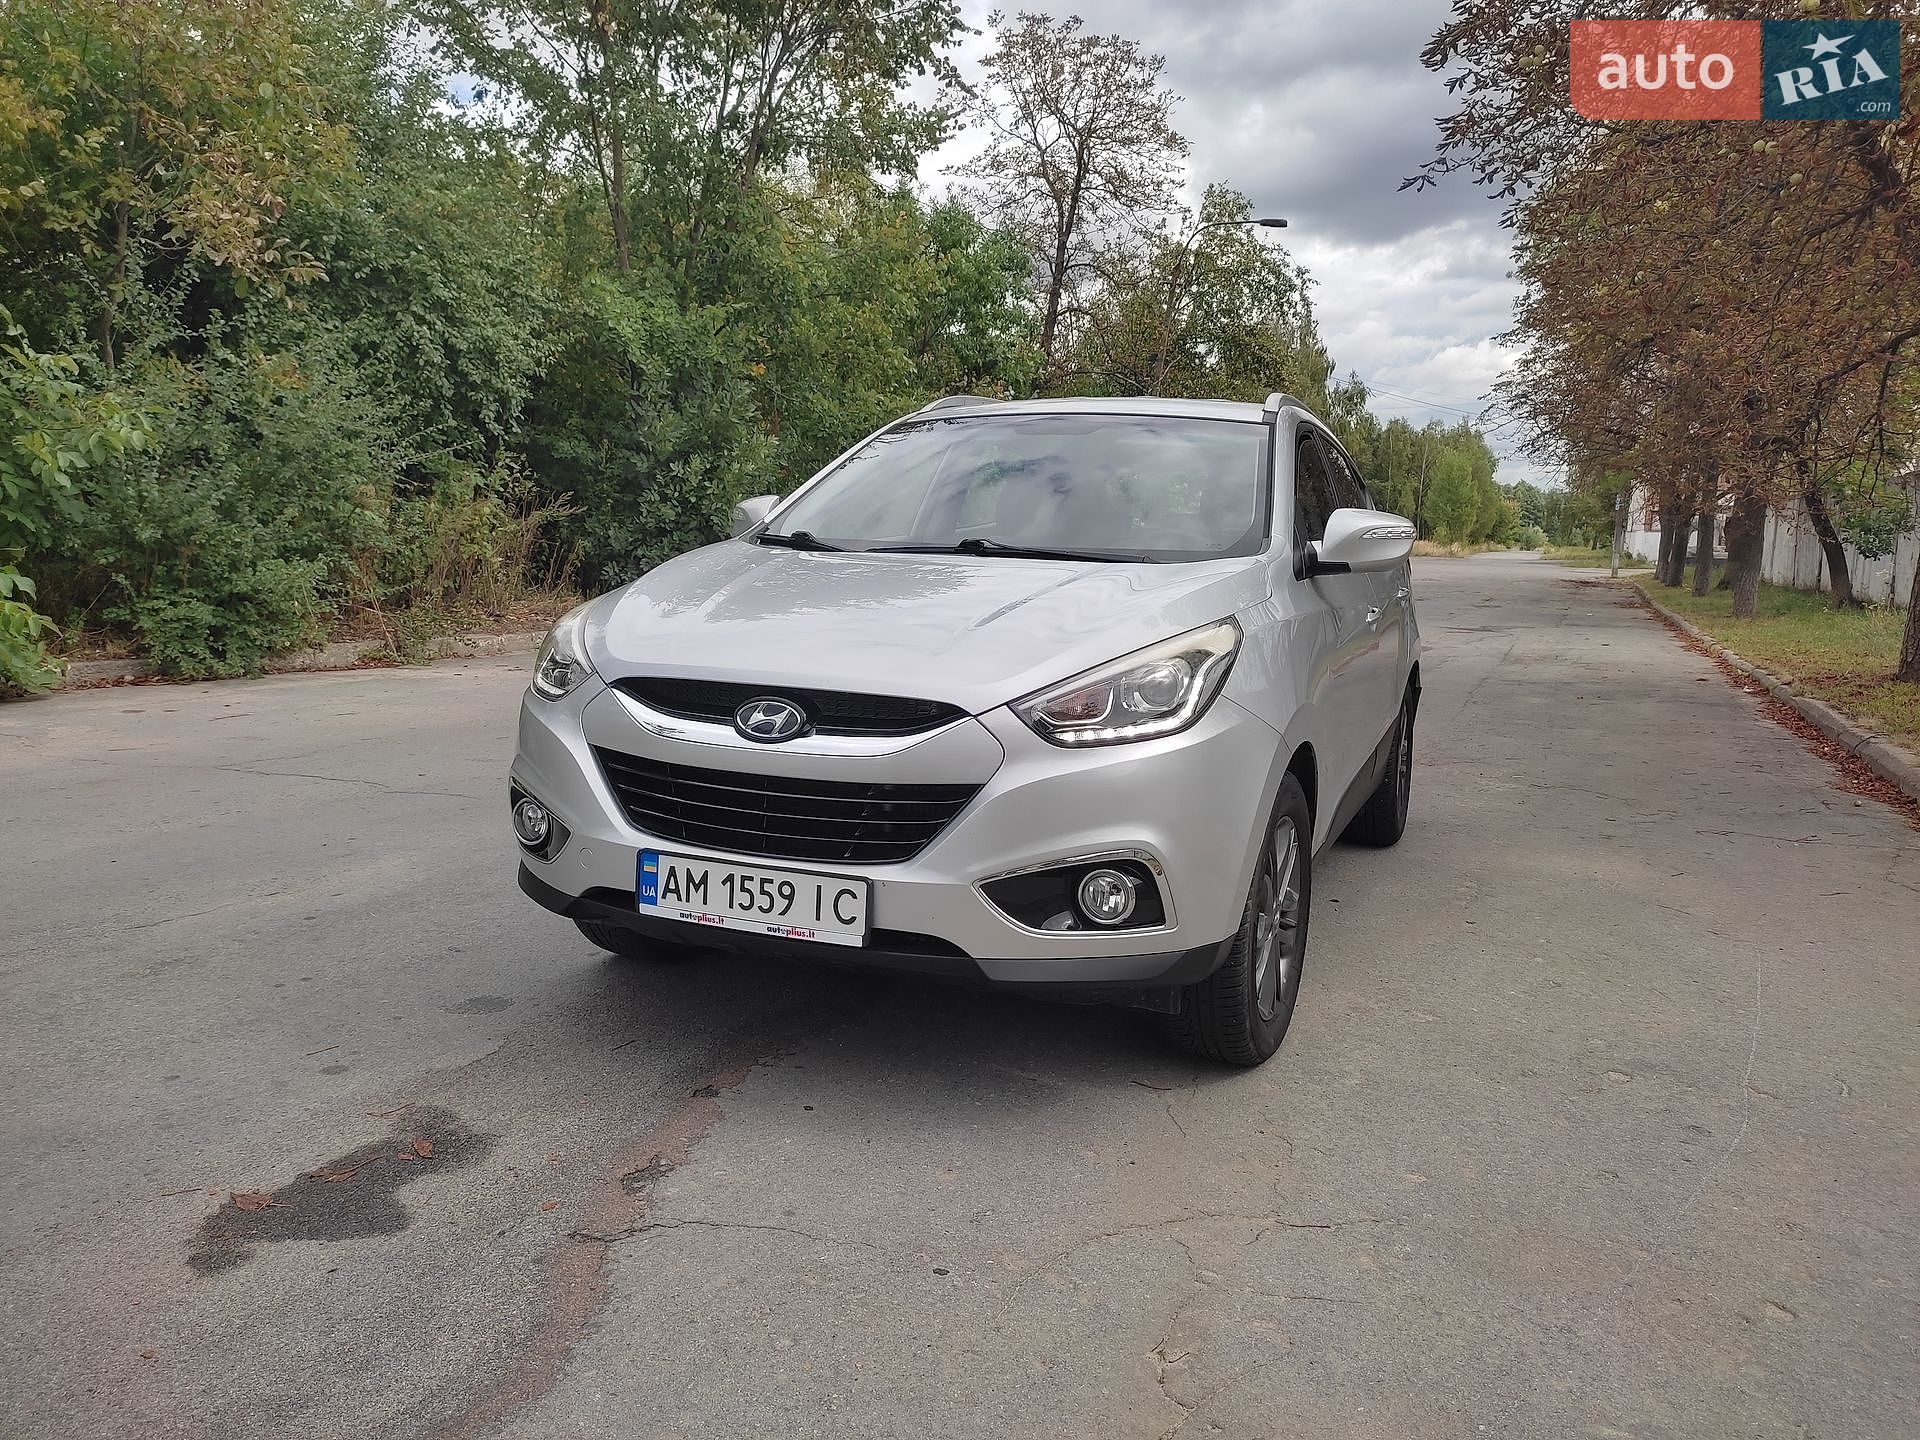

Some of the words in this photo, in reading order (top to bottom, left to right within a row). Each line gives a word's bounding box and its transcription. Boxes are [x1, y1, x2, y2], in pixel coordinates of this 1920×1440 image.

[642, 885, 656, 898] UA
[661, 865, 709, 905] AM
[721, 873, 795, 916] 1559
[679, 911, 725, 925] autoplius.lt
[766, 925, 815, 939] autoplius.lt
